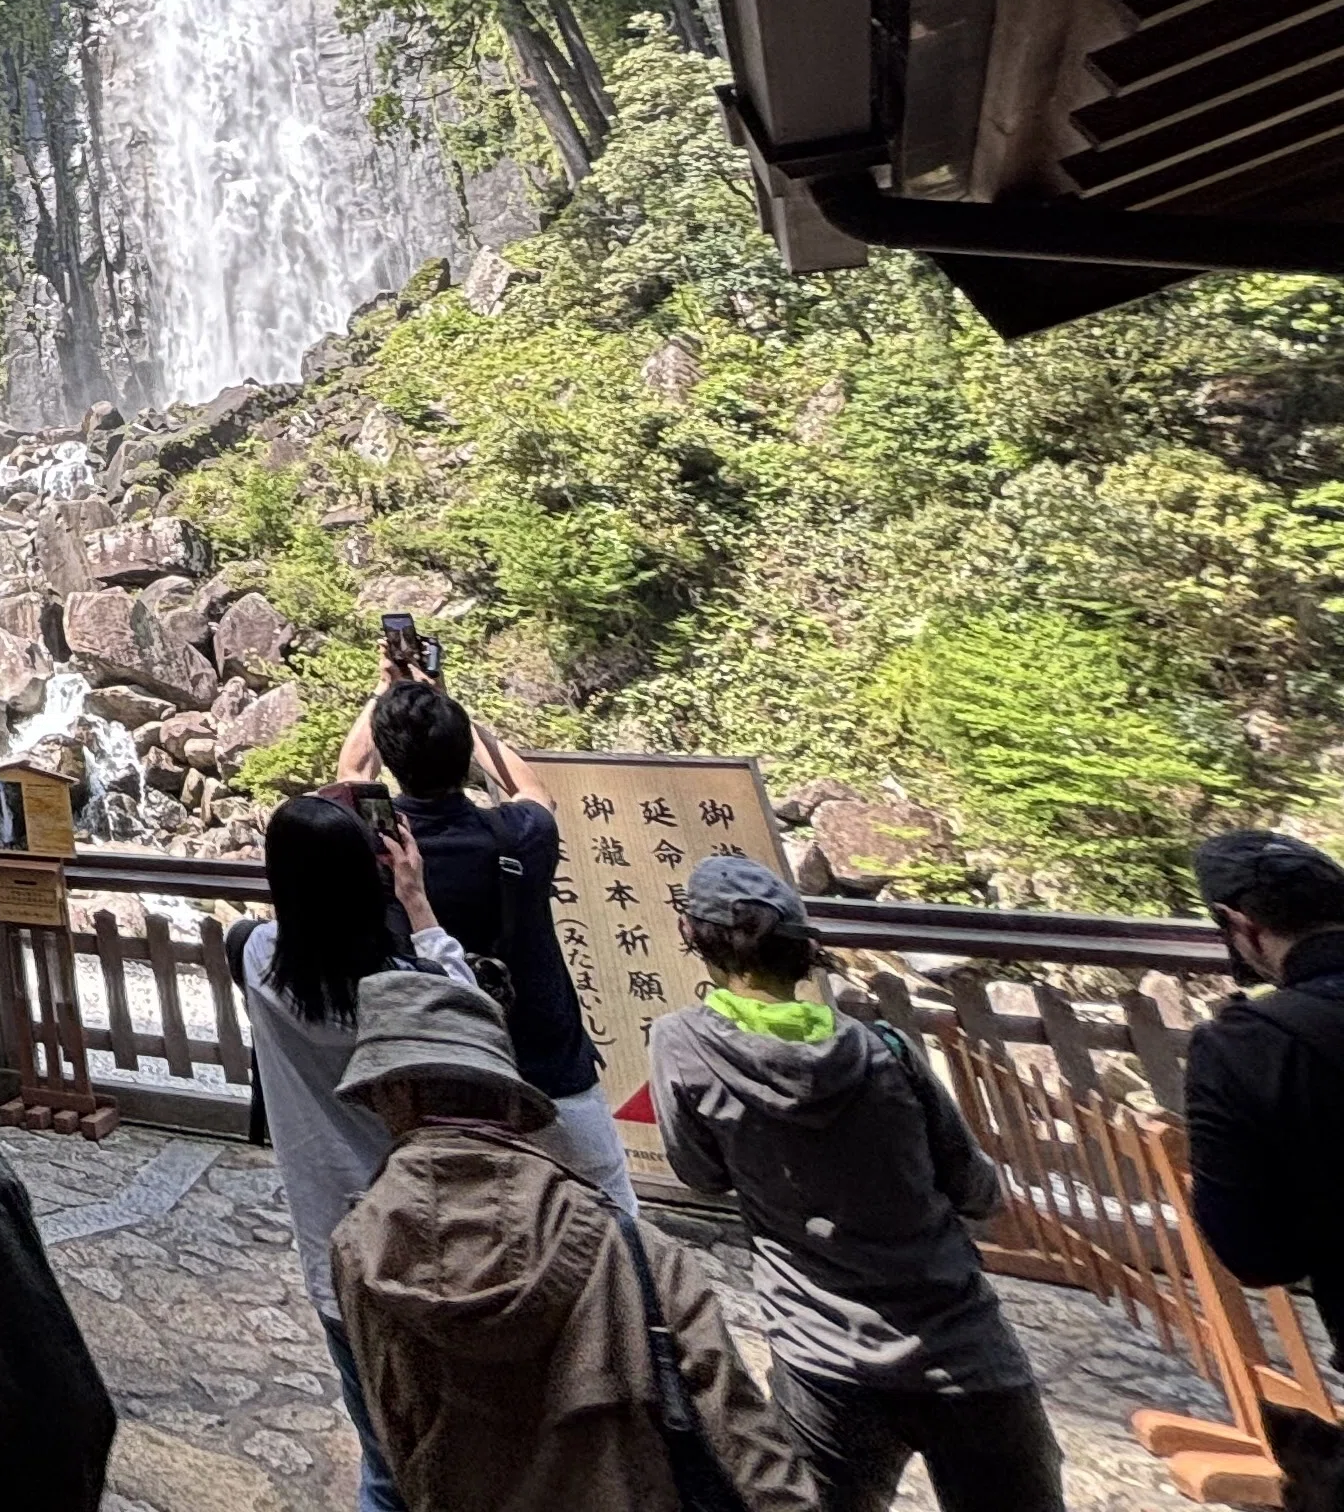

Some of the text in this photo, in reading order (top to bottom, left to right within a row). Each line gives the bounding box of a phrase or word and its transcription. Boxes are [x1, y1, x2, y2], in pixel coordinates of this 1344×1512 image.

[548, 837, 618, 1046] 石（みたまいし）
